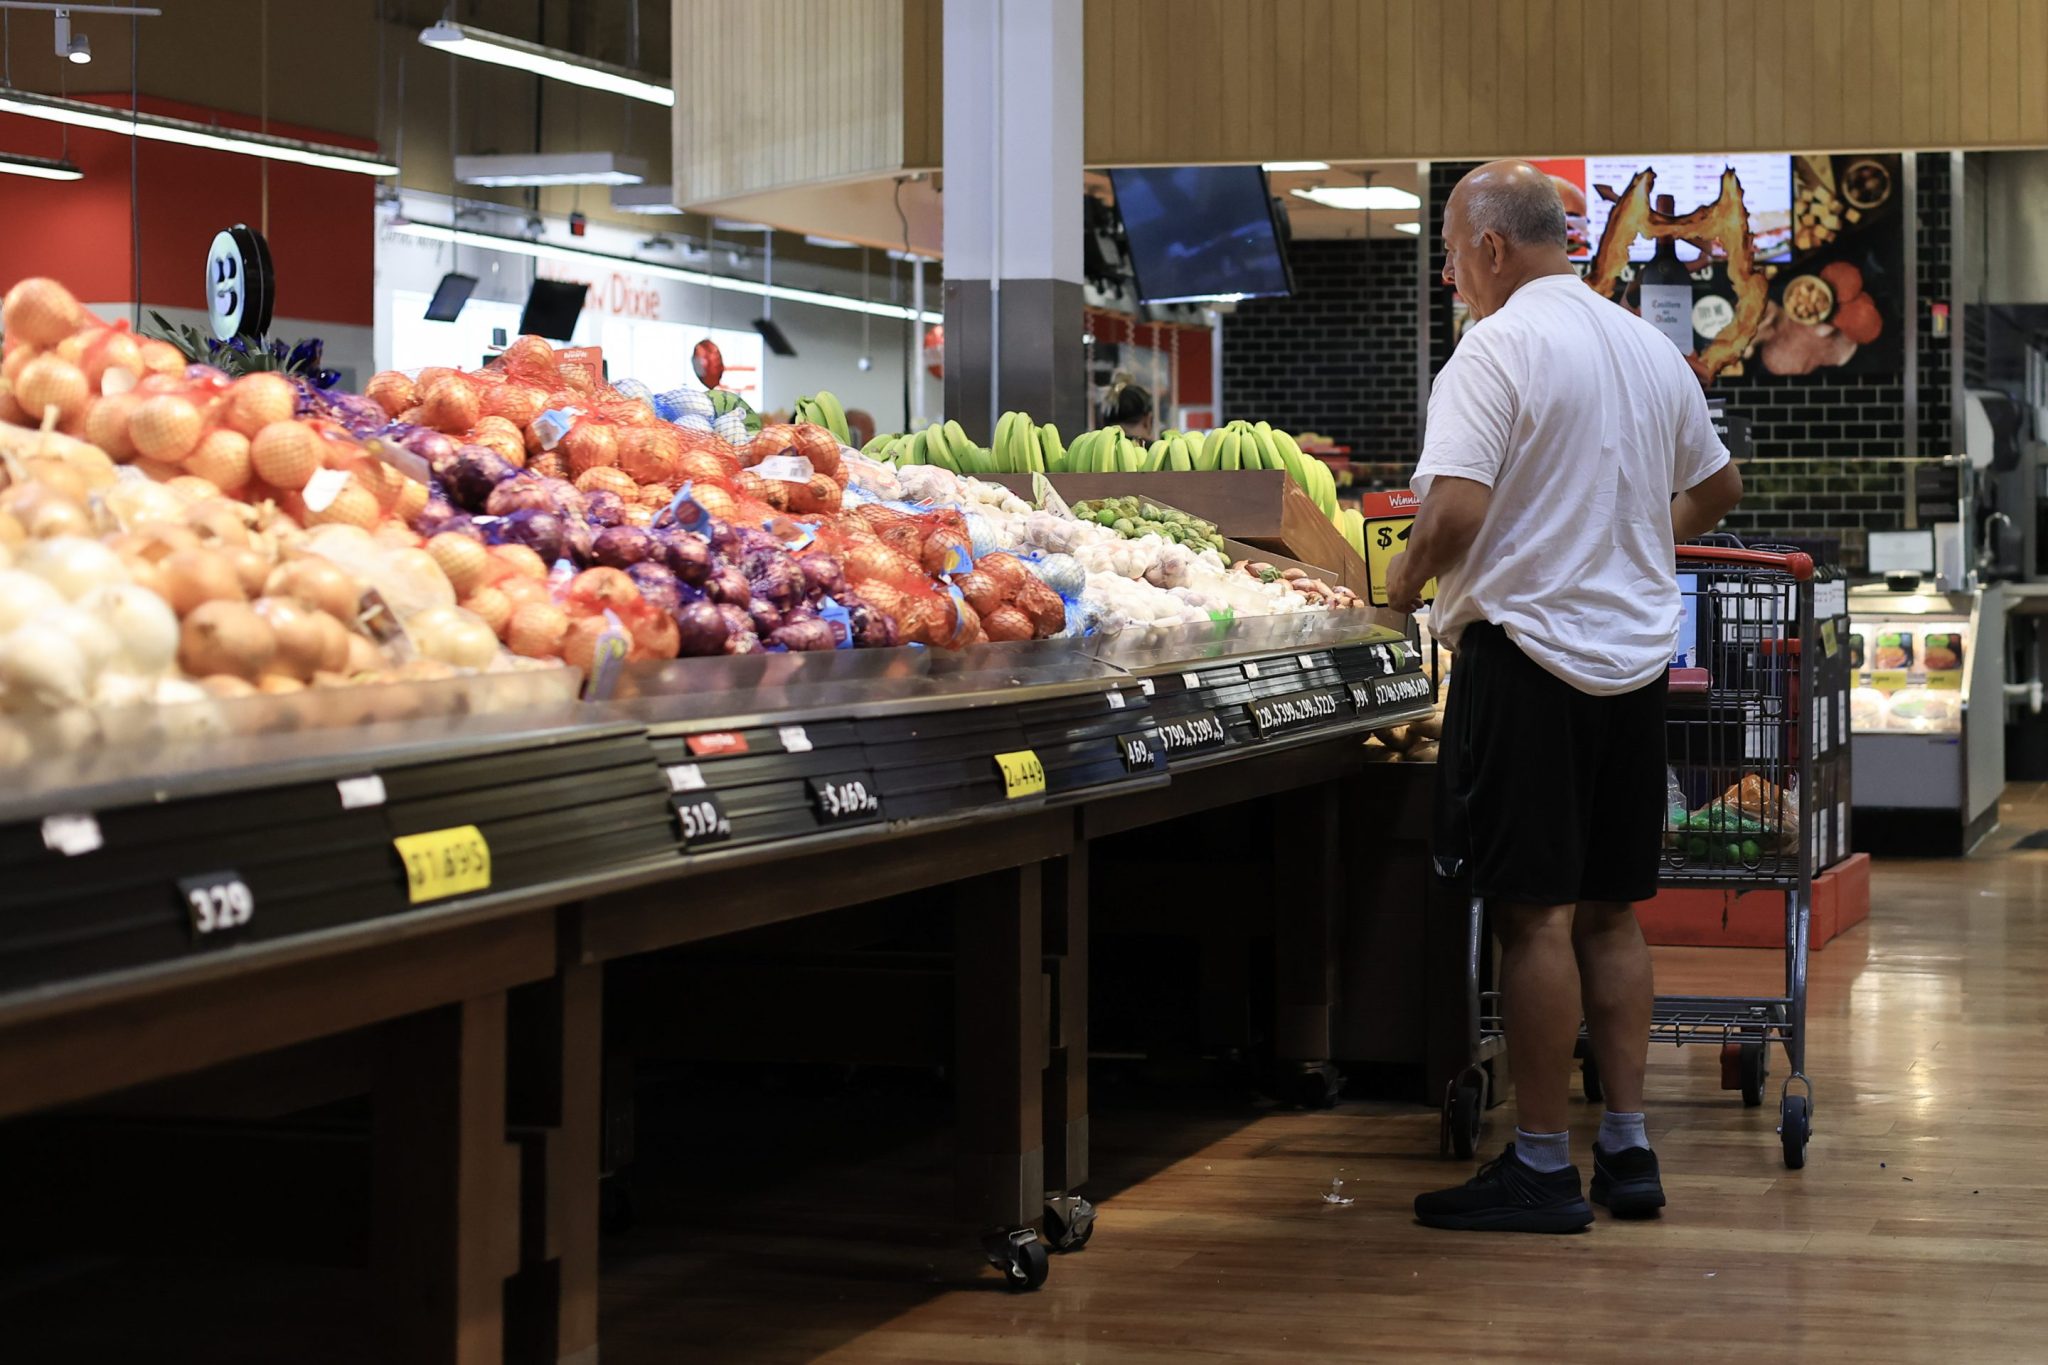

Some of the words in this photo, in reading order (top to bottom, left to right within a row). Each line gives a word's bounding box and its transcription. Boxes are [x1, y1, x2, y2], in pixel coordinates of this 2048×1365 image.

[611, 273, 660, 321] Dixie
[1127, 740, 1147, 766] 469
[678, 800, 718, 839] 519
[188, 878, 254, 934] 329
